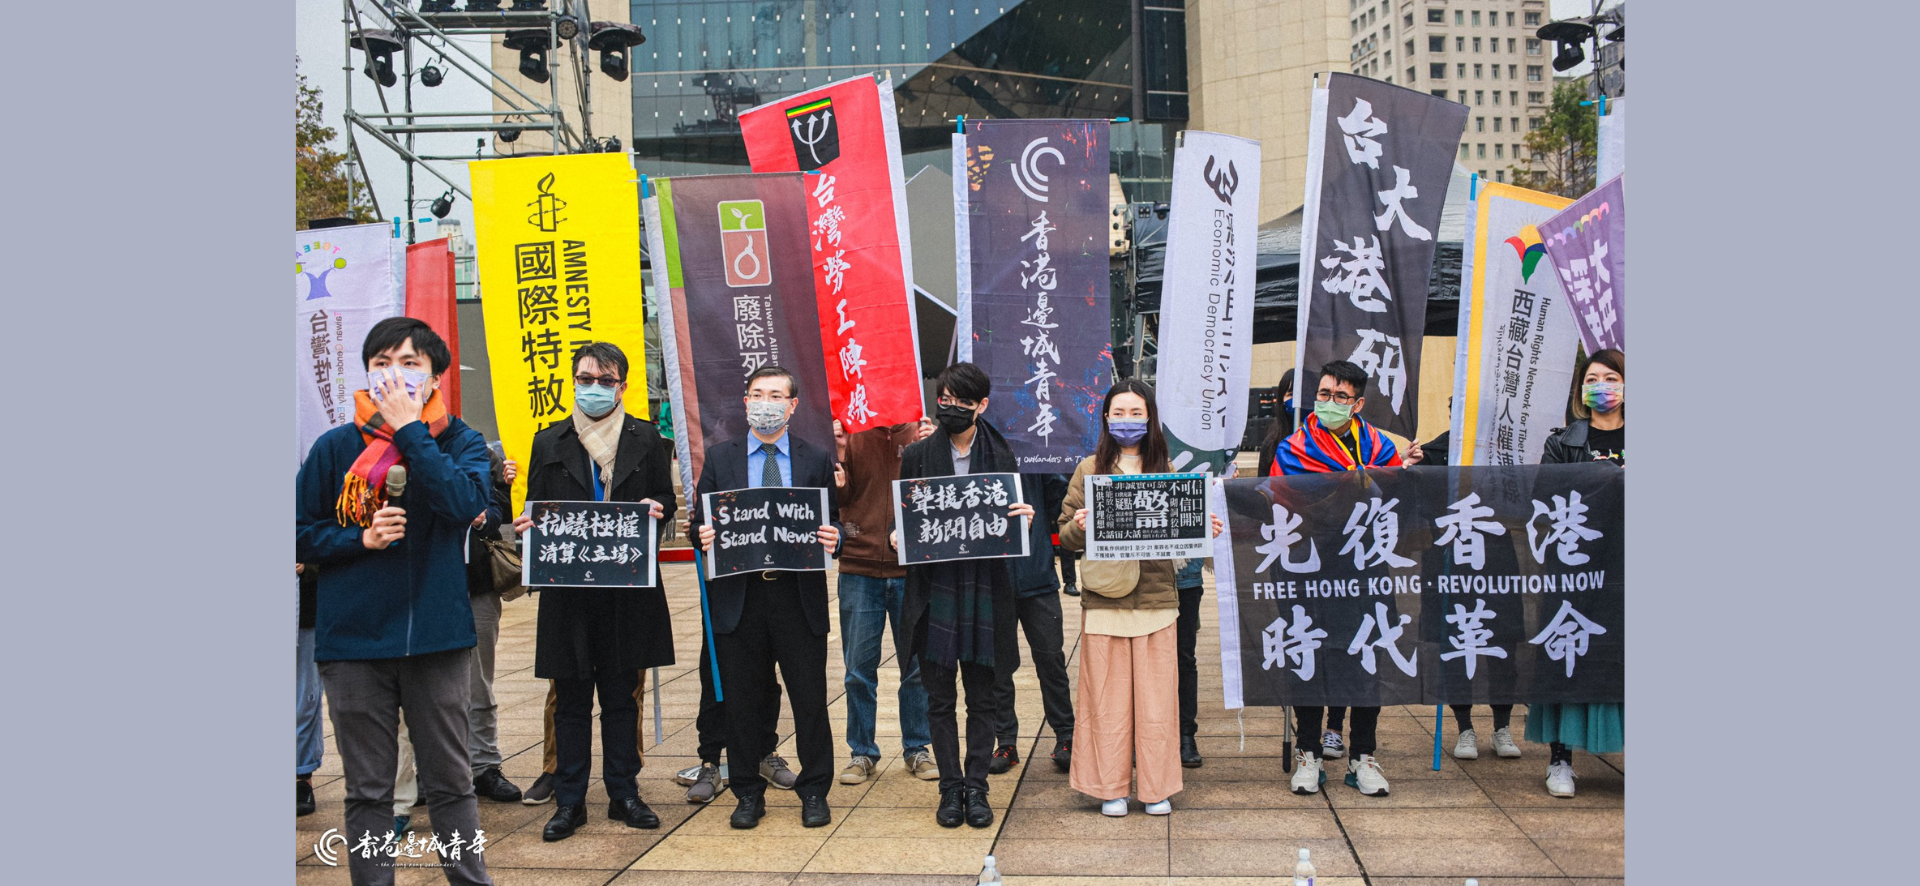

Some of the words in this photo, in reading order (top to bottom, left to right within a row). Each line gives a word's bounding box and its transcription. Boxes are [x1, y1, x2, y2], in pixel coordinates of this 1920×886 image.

[1209, 208, 1225, 287] Economic
[562, 239, 592, 332] AMNESTY
[812, 173, 878, 424] 台灣勞工陣線
[764, 294, 774, 334] Taiwan
[769, 337, 779, 367] Allian
[1020, 210, 1060, 448] 香港邊城青年
[1536, 297, 1551, 332] Human
[733, 294, 768, 394] 廢除死
[1200, 293, 1220, 383] Democracy
[1530, 334, 1544, 366] Rights
[1522, 368, 1538, 409] Network
[1201, 388, 1215, 431] Union
[1521, 412, 1530, 427] for
[1518, 428, 1527, 453] Tibet
[719, 501, 770, 525] Stand
[776, 502, 815, 520] With
[911, 479, 1008, 515] 聲援香港
[1133, 490, 1169, 529] 警
[537, 509, 640, 540] 抗議極權
[720, 525, 767, 549] Stand
[773, 526, 817, 543] News
[1255, 490, 1604, 574] 光復香港
[539, 541, 643, 564] 清算《立場》
[1253, 581, 1297, 600] FREE
[1305, 578, 1360, 598] HONG
[1368, 575, 1422, 596] KONG
[1438, 575, 1556, 594] REVOLUTION
[1561, 570, 1605, 592] NOW
[1262, 598, 1607, 682] 時代革命
